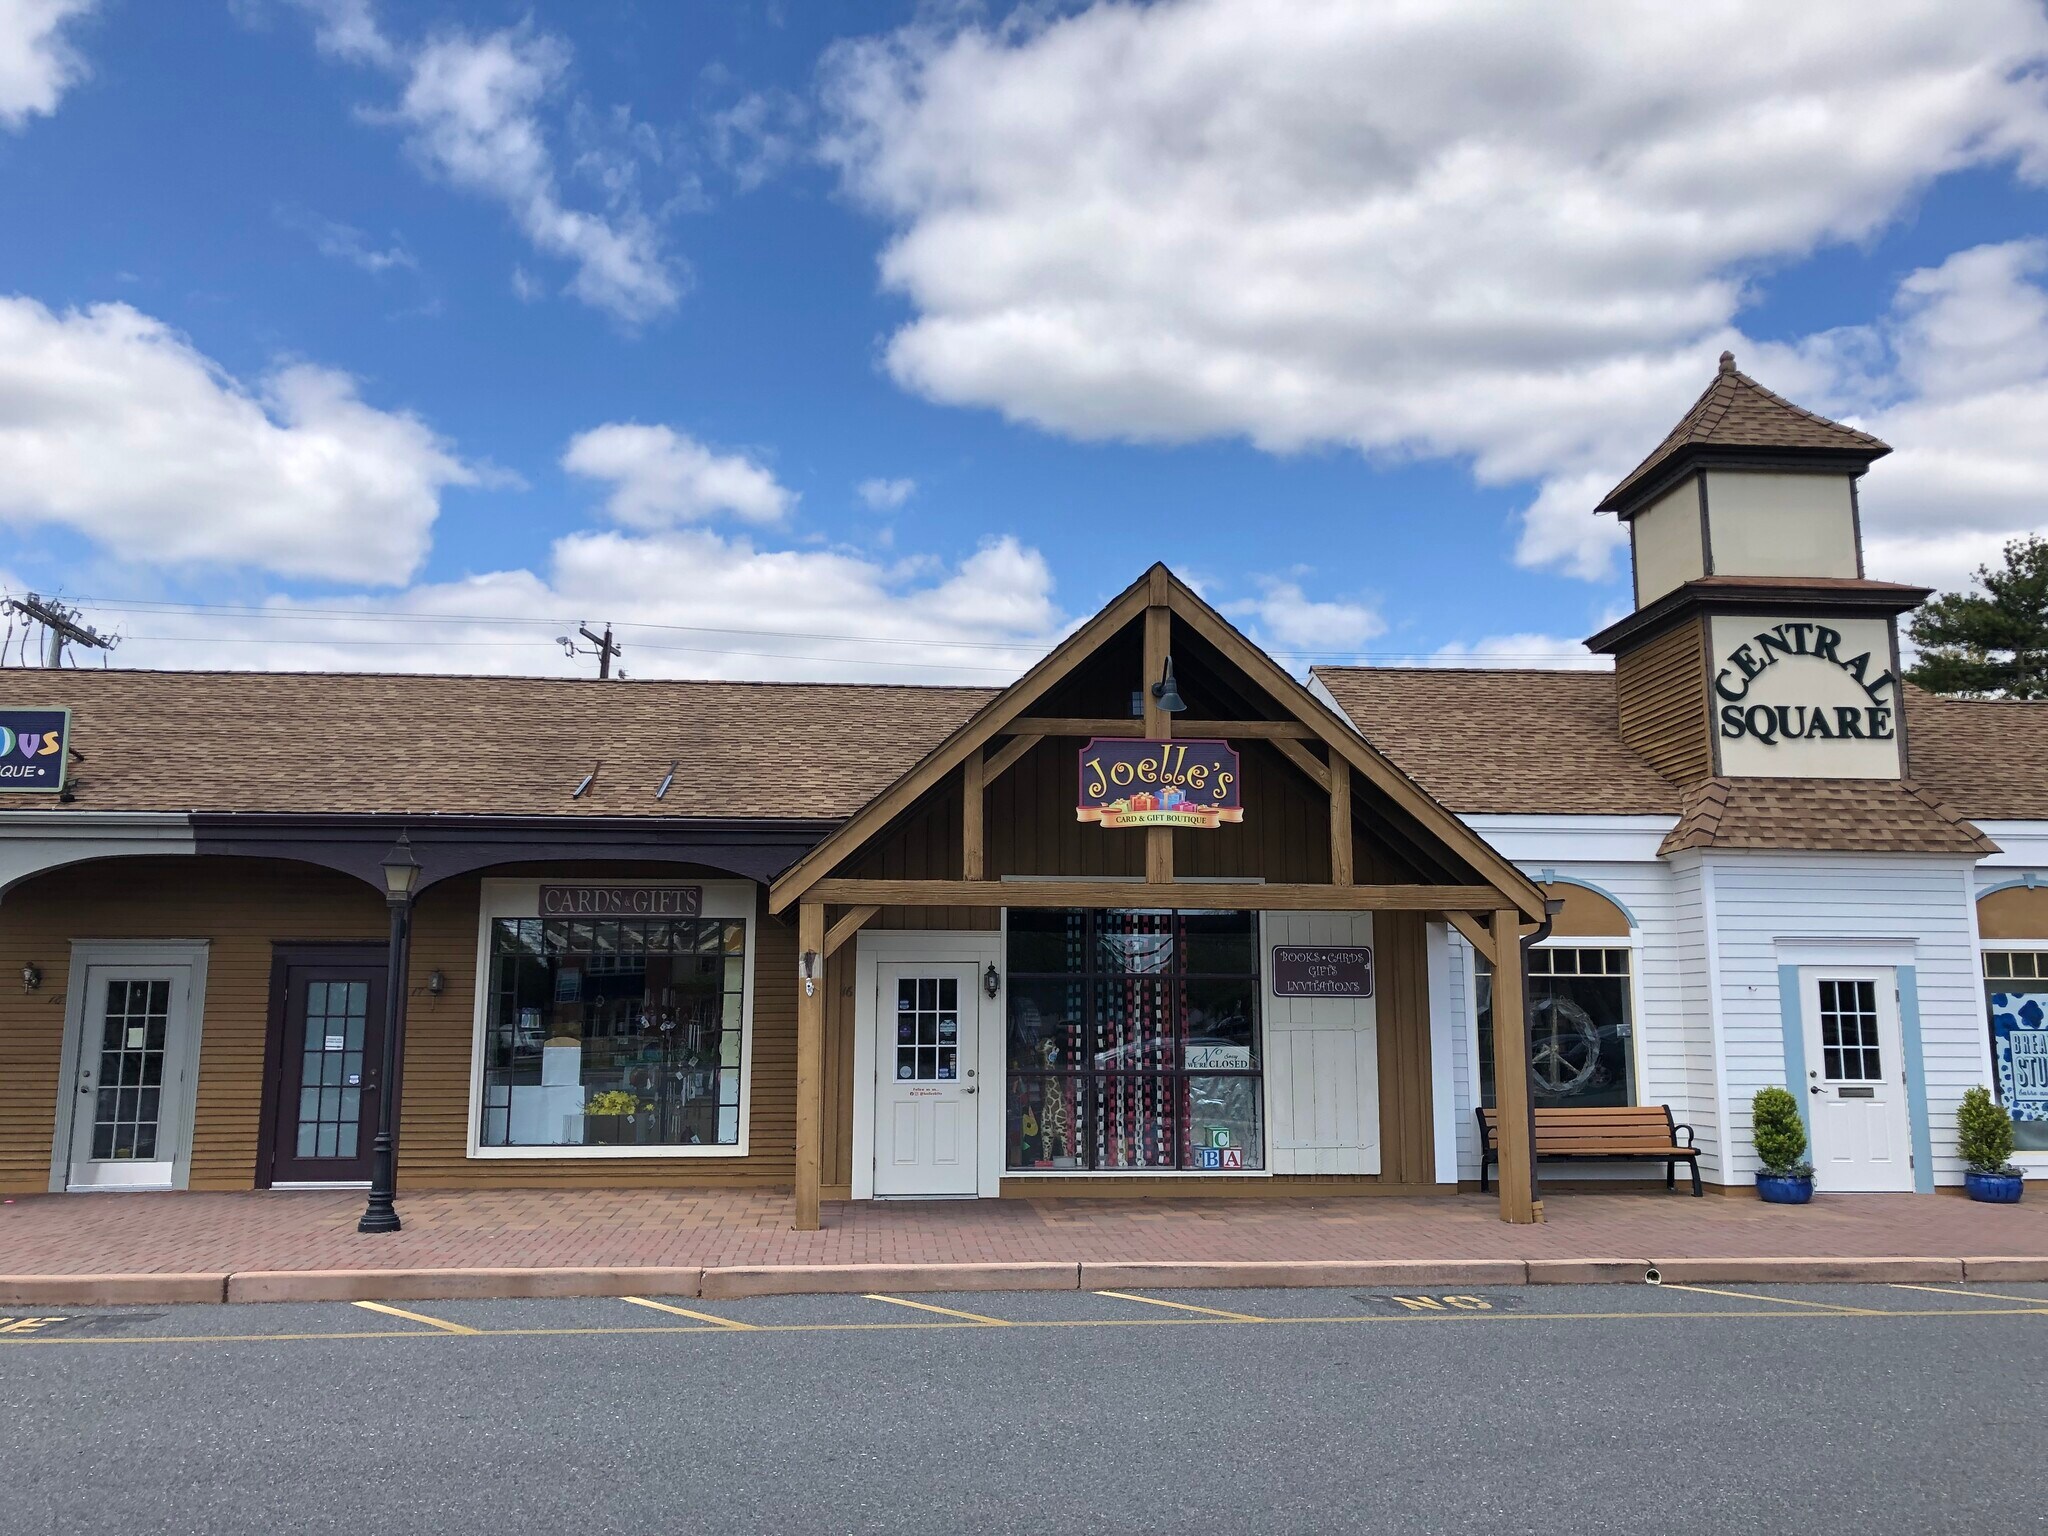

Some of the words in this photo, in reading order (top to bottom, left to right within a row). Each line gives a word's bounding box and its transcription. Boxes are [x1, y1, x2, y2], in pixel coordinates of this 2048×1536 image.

[1715, 623, 1896, 706] CENTRAL
[1721, 704, 1894, 745] SQUARE
[1085, 744, 1234, 799] Joelle's
[1116, 815, 1137, 824] CARD
[1147, 814, 1165, 822] GIFT
[1166, 814, 1207, 825] BOUTIQUE
[545, 889, 622, 912] CARDS
[633, 890, 697, 913] GIFTS
[1280, 951, 1320, 963] BOOKS
[1327, 952, 1365, 964] CARDS
[1308, 964, 1338, 978] GIFTS
[1287, 980, 1360, 992] INVITATIONS
[2013, 1034, 2048, 1055] BREA
[1208, 1060, 1248, 1068] CLOSED
[1214, 1131, 1228, 1147] C
[1205, 1151, 1219, 1166] B
[1225, 1151, 1240, 1166] A
